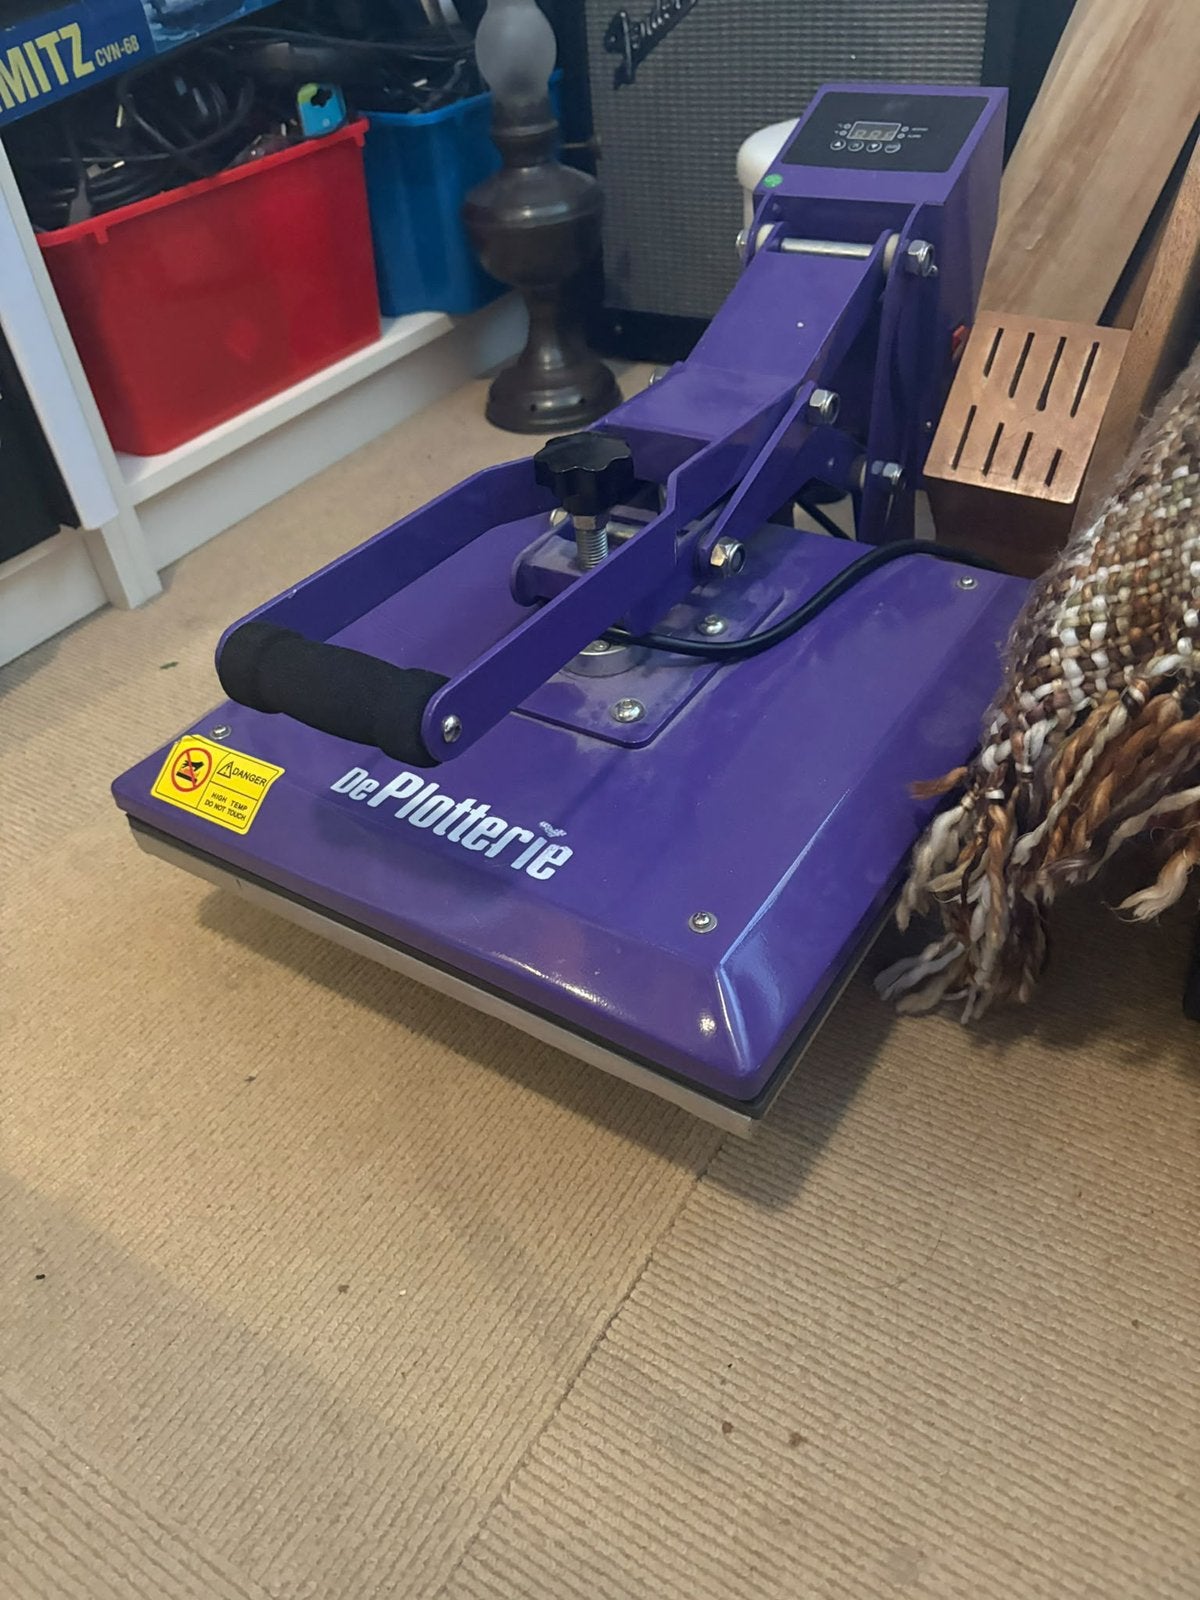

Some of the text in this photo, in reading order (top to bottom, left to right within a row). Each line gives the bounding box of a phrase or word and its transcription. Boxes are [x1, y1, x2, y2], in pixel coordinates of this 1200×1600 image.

[0, 22, 140, 113] MITZ CVN-68
[232, 767, 267, 786] DANGER
[204, 799, 246, 820] DO NOT TOUCH
[211, 793, 248, 811] HIGH TEMP
